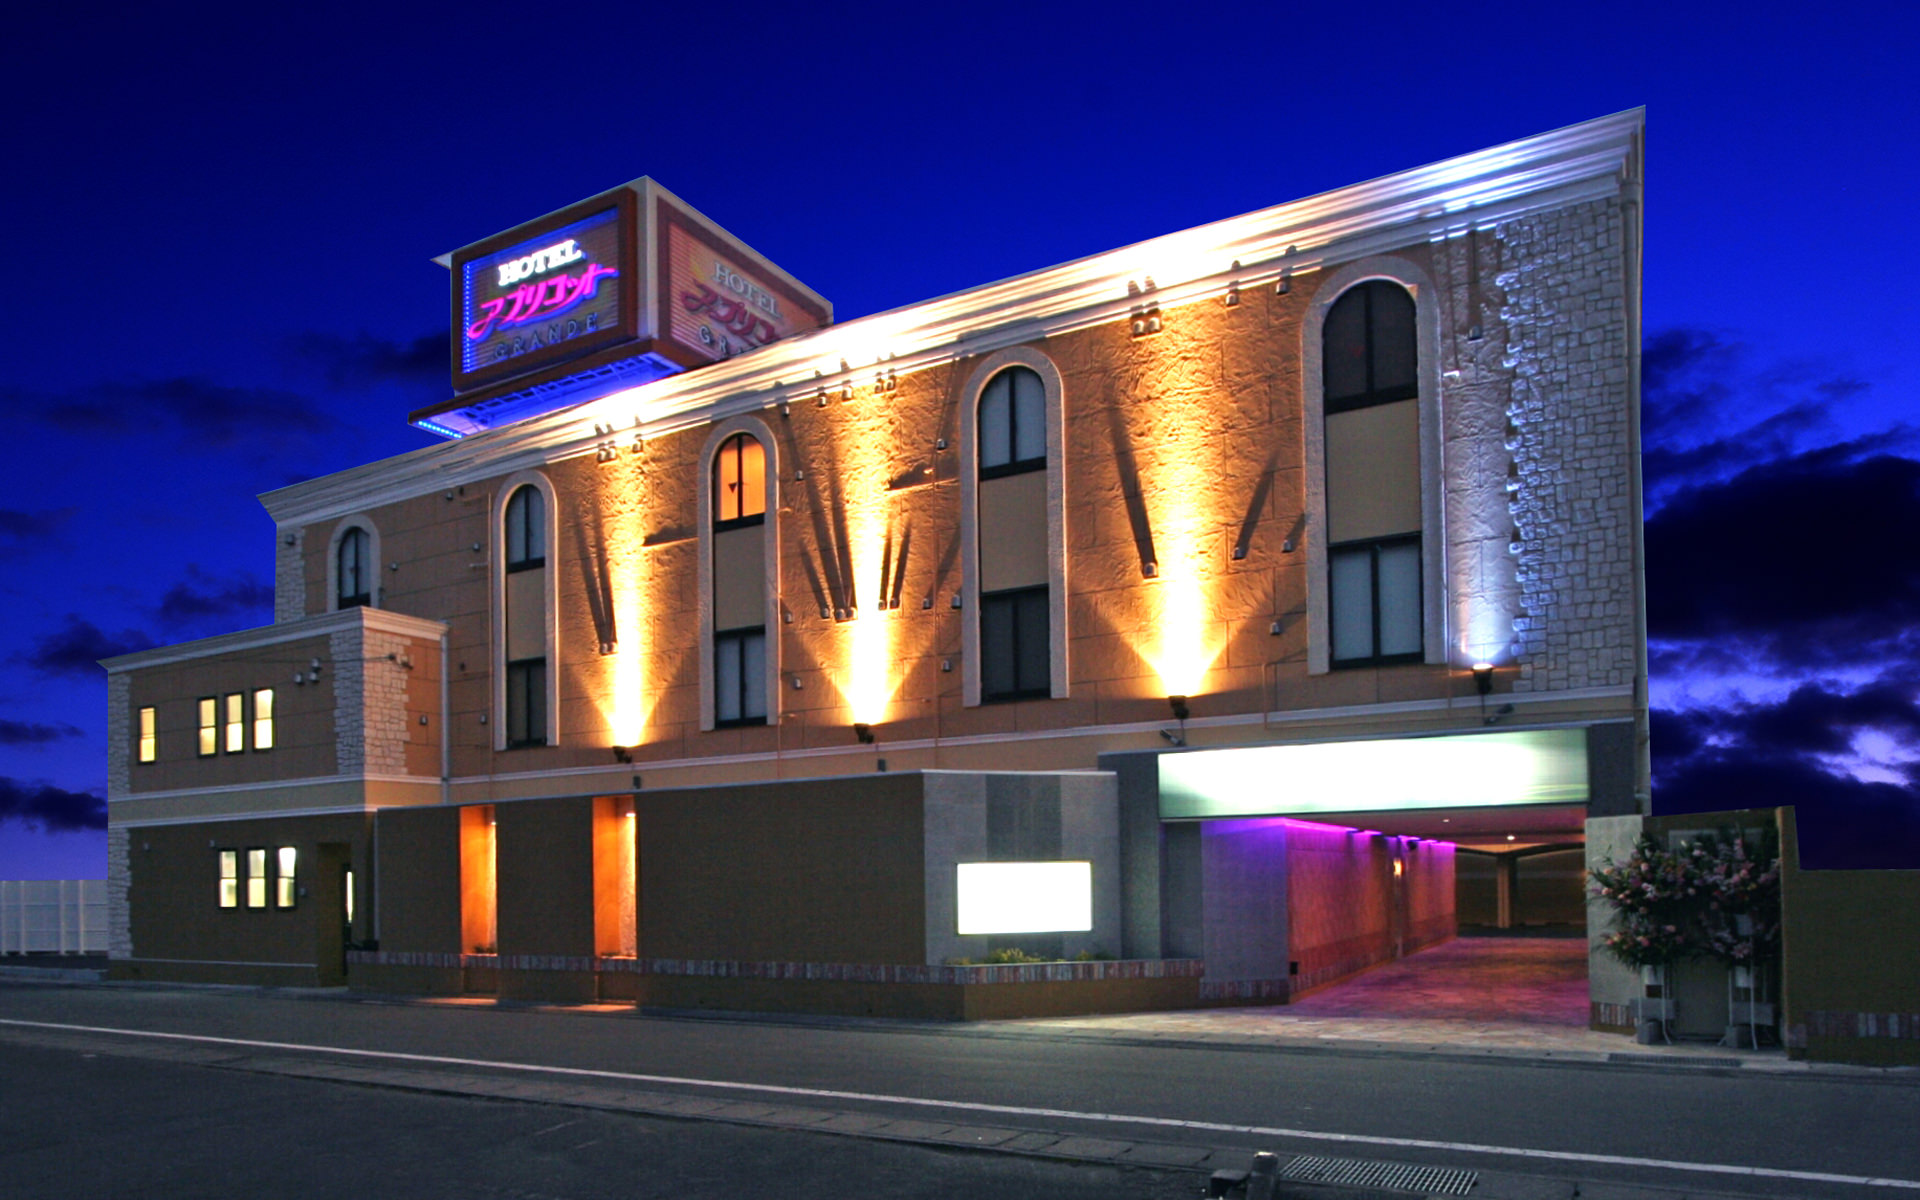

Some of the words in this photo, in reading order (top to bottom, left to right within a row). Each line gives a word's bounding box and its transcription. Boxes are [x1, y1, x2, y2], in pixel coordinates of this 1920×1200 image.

[498, 239, 583, 287] HOTEL
[711, 261, 784, 320] HOTEL
[467, 263, 618, 340] アプリコット
[680, 278, 780, 347] アプリコ
[494, 312, 599, 360] GRANDE
